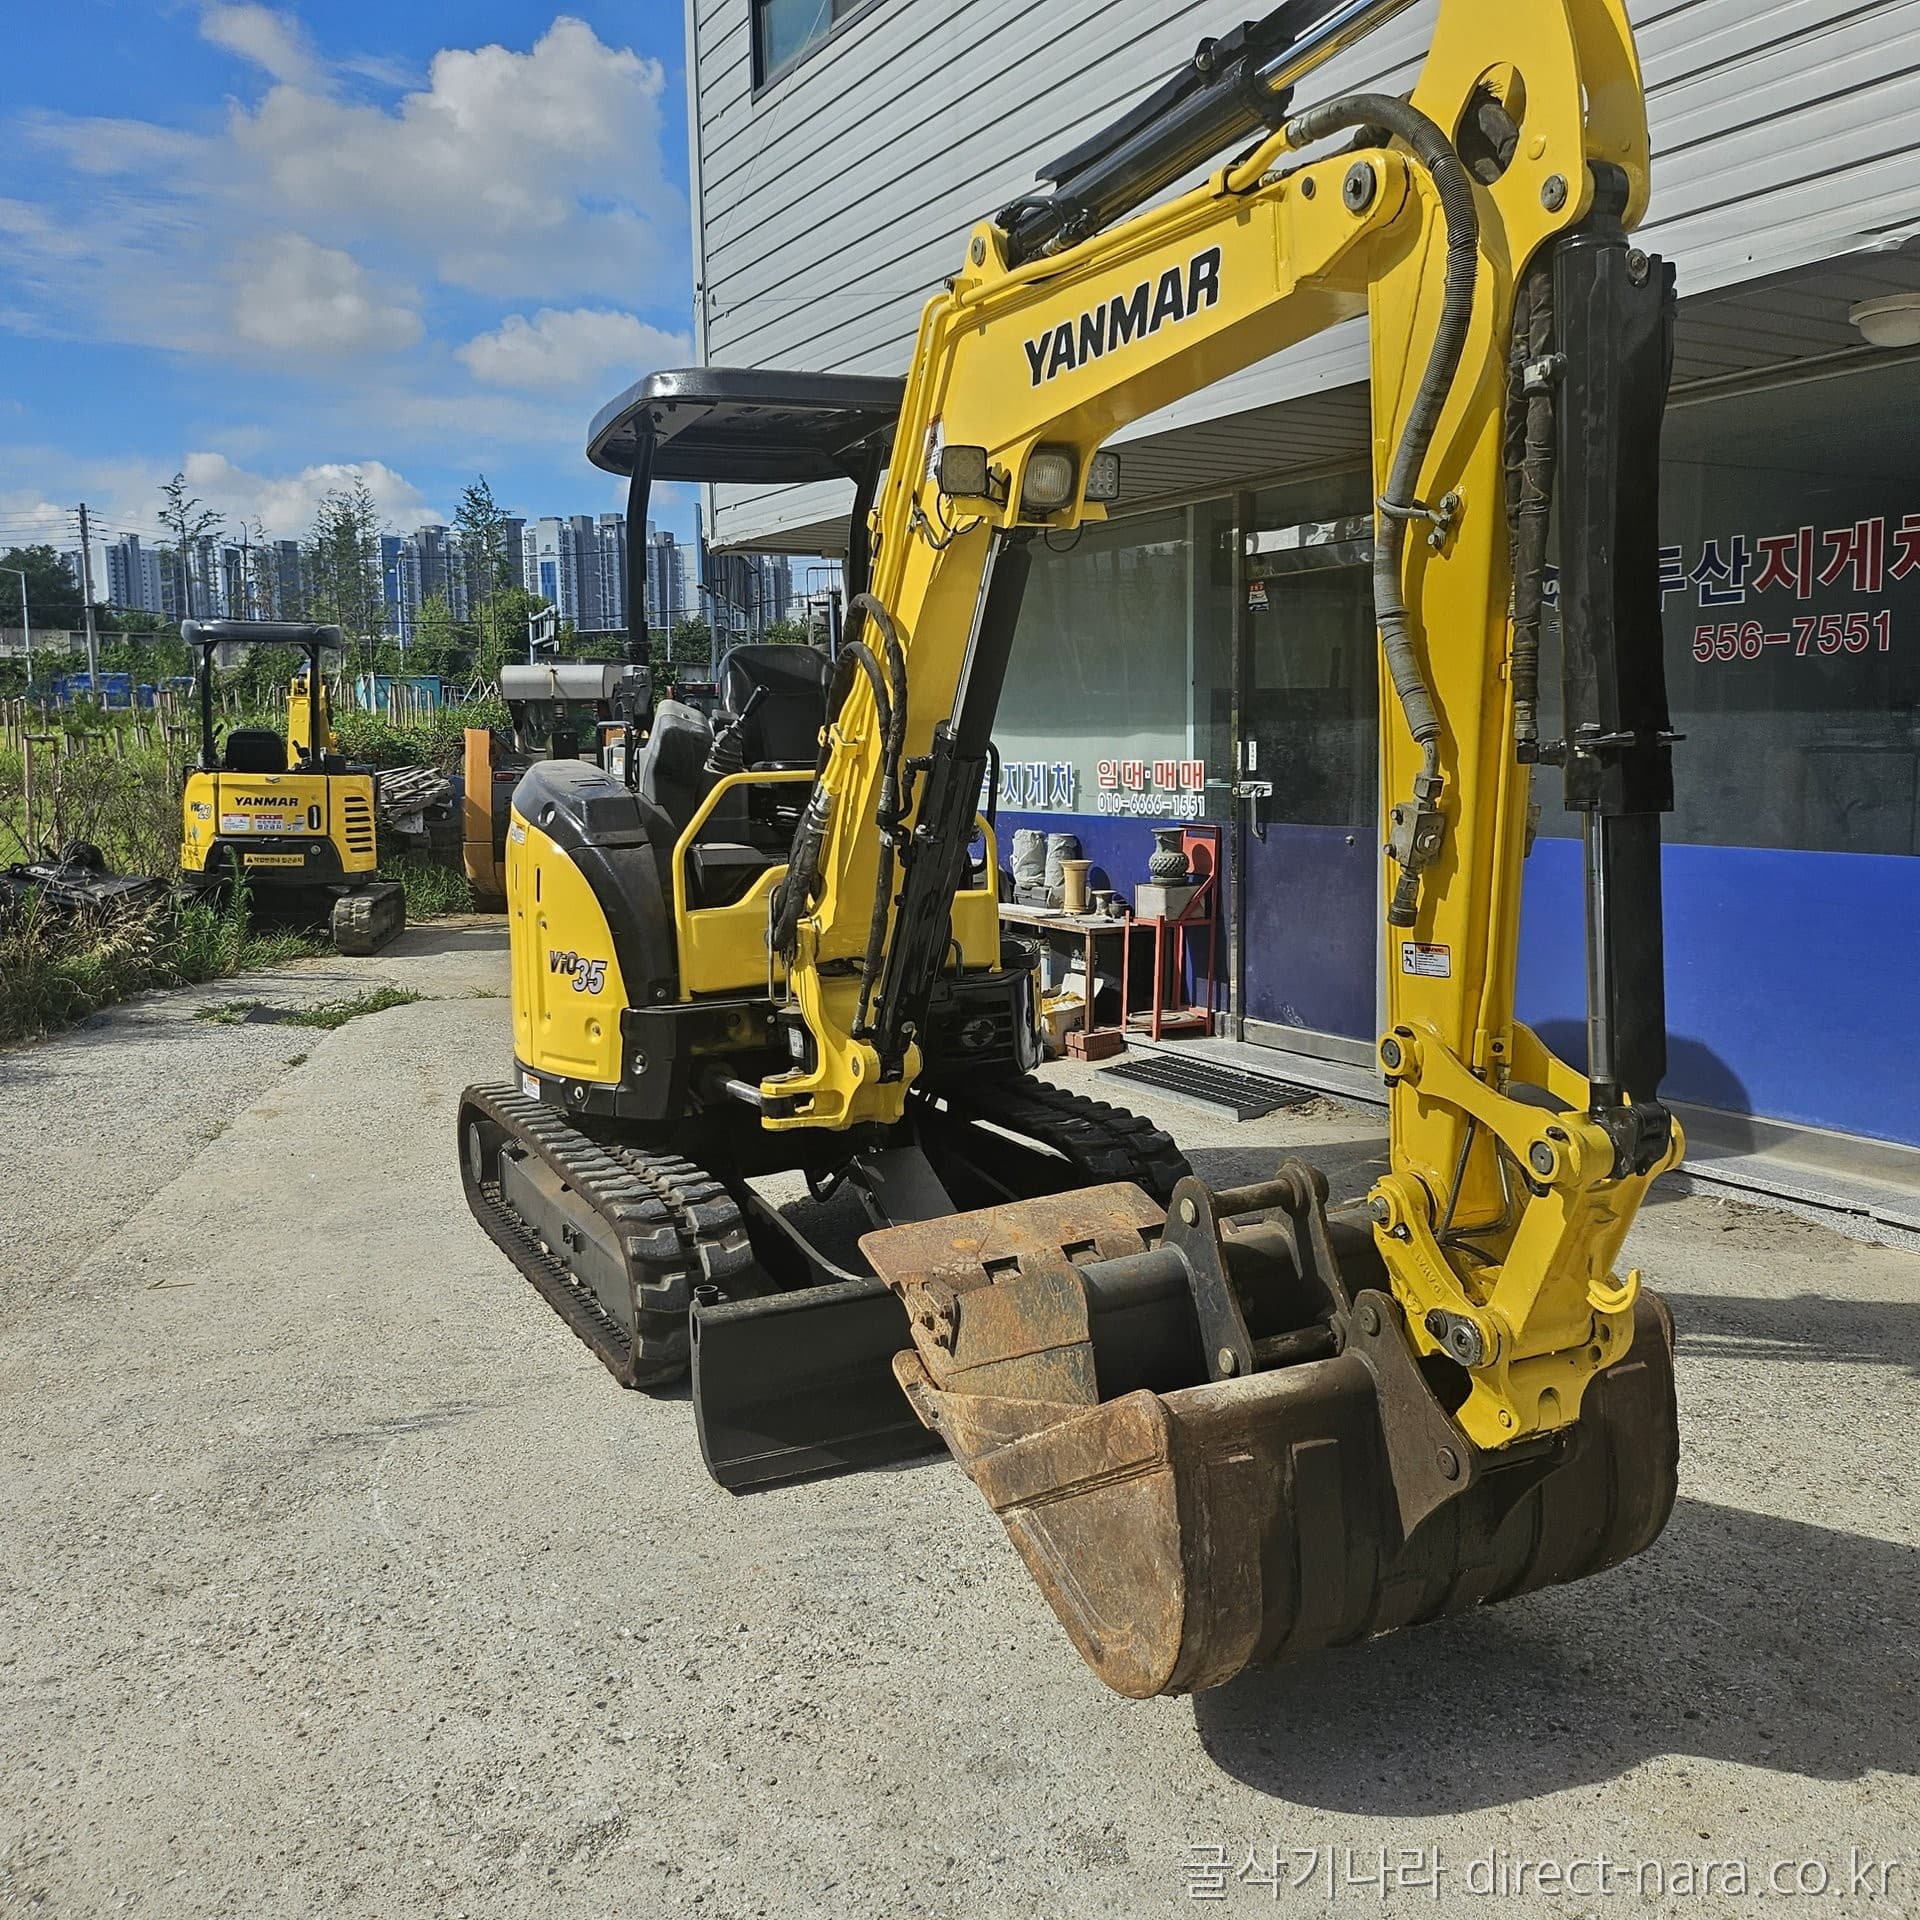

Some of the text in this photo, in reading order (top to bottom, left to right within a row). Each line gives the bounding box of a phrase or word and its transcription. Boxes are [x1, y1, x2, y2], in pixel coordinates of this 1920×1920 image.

[1024, 247, 1221, 387] YANMAR
[1693, 610, 1890, 662] 556-7551
[235, 797, 299, 807] YANMAR
[1097, 793, 1205, 816] 010-6666-1551
